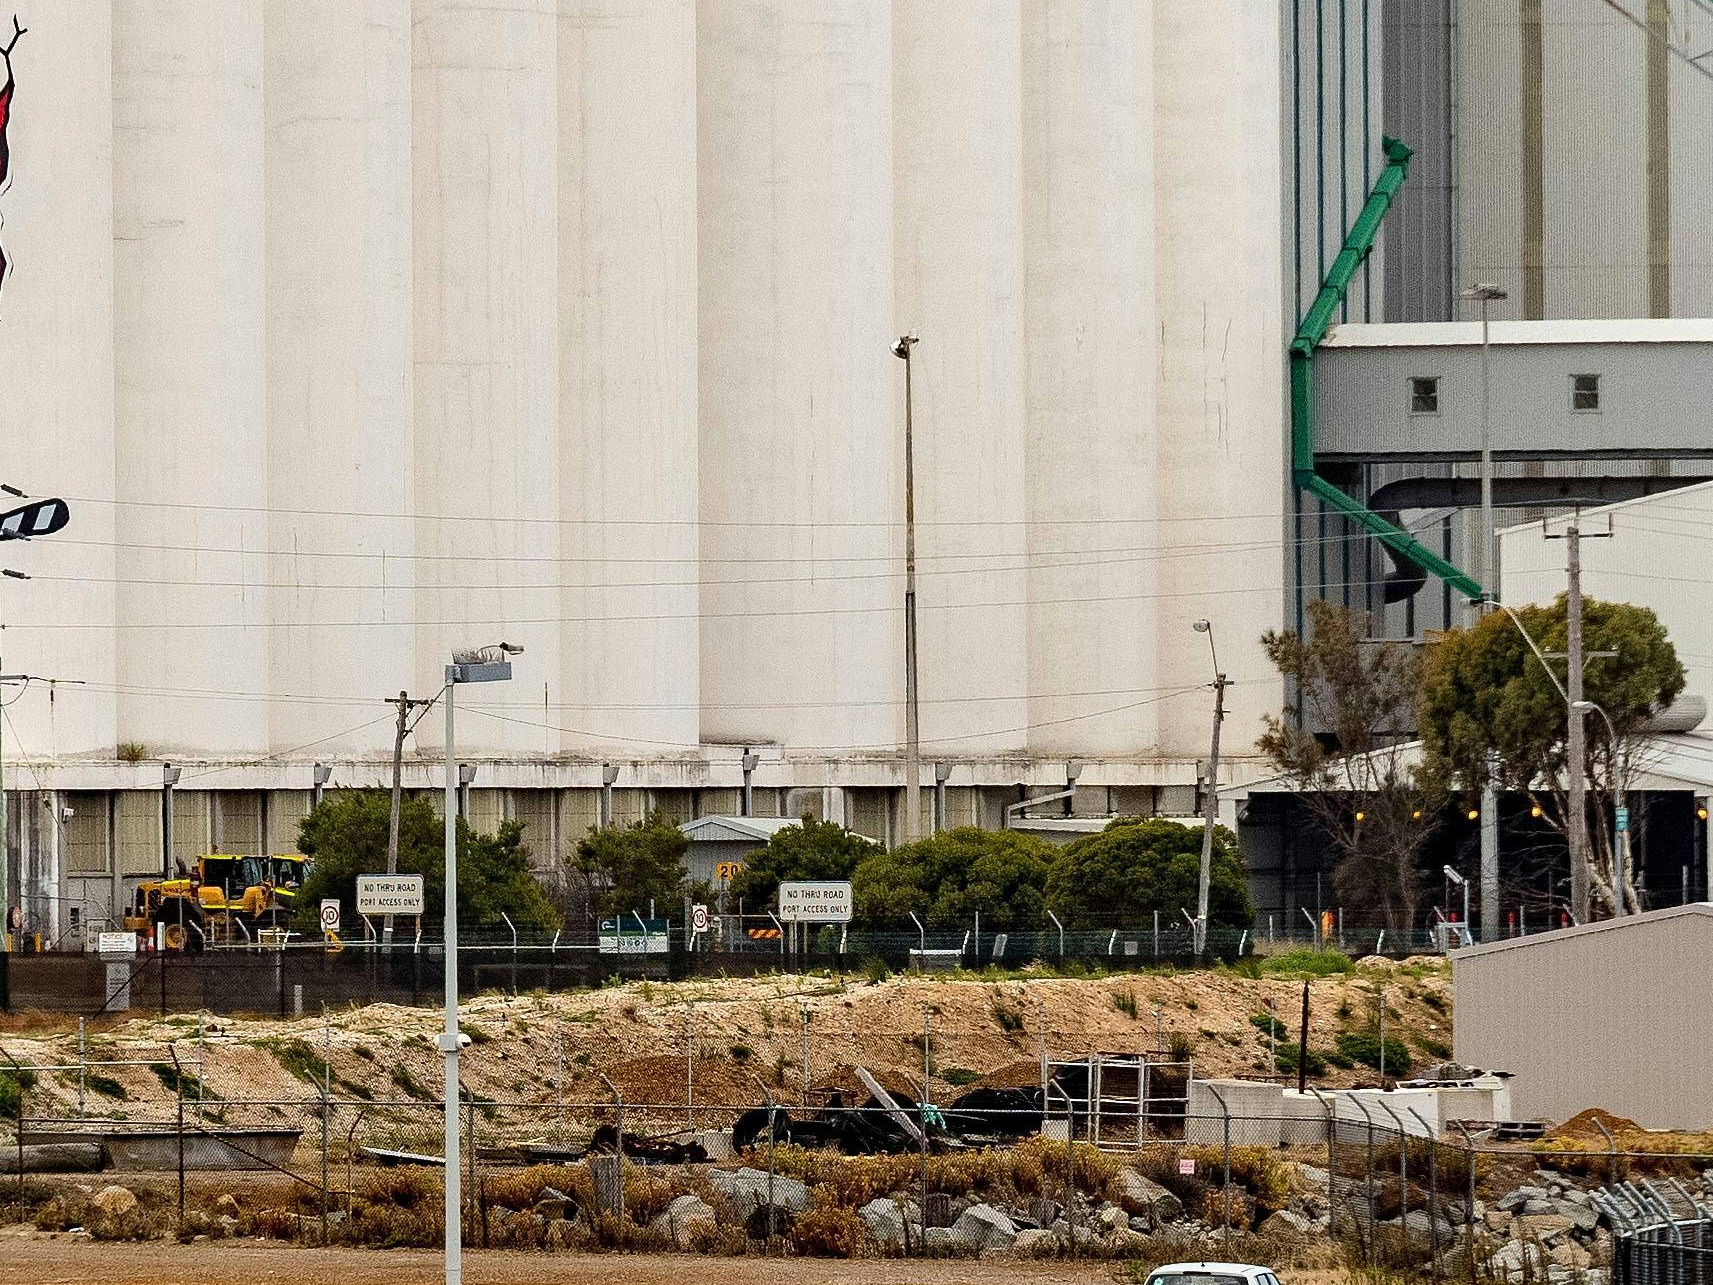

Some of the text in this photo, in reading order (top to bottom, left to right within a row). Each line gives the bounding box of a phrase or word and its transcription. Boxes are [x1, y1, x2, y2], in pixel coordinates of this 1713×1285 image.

[720, 865, 739, 877] 20
[364, 883, 416, 892] NO THRU ROAD
[786, 889, 844, 899] NO THRU ROAD
[360, 898, 420, 906] PORT ACCESS ONLY
[783, 905, 848, 914] PORT ACCESS ONLY
[327, 910, 335, 920] 10
[695, 913, 704, 923] 10
